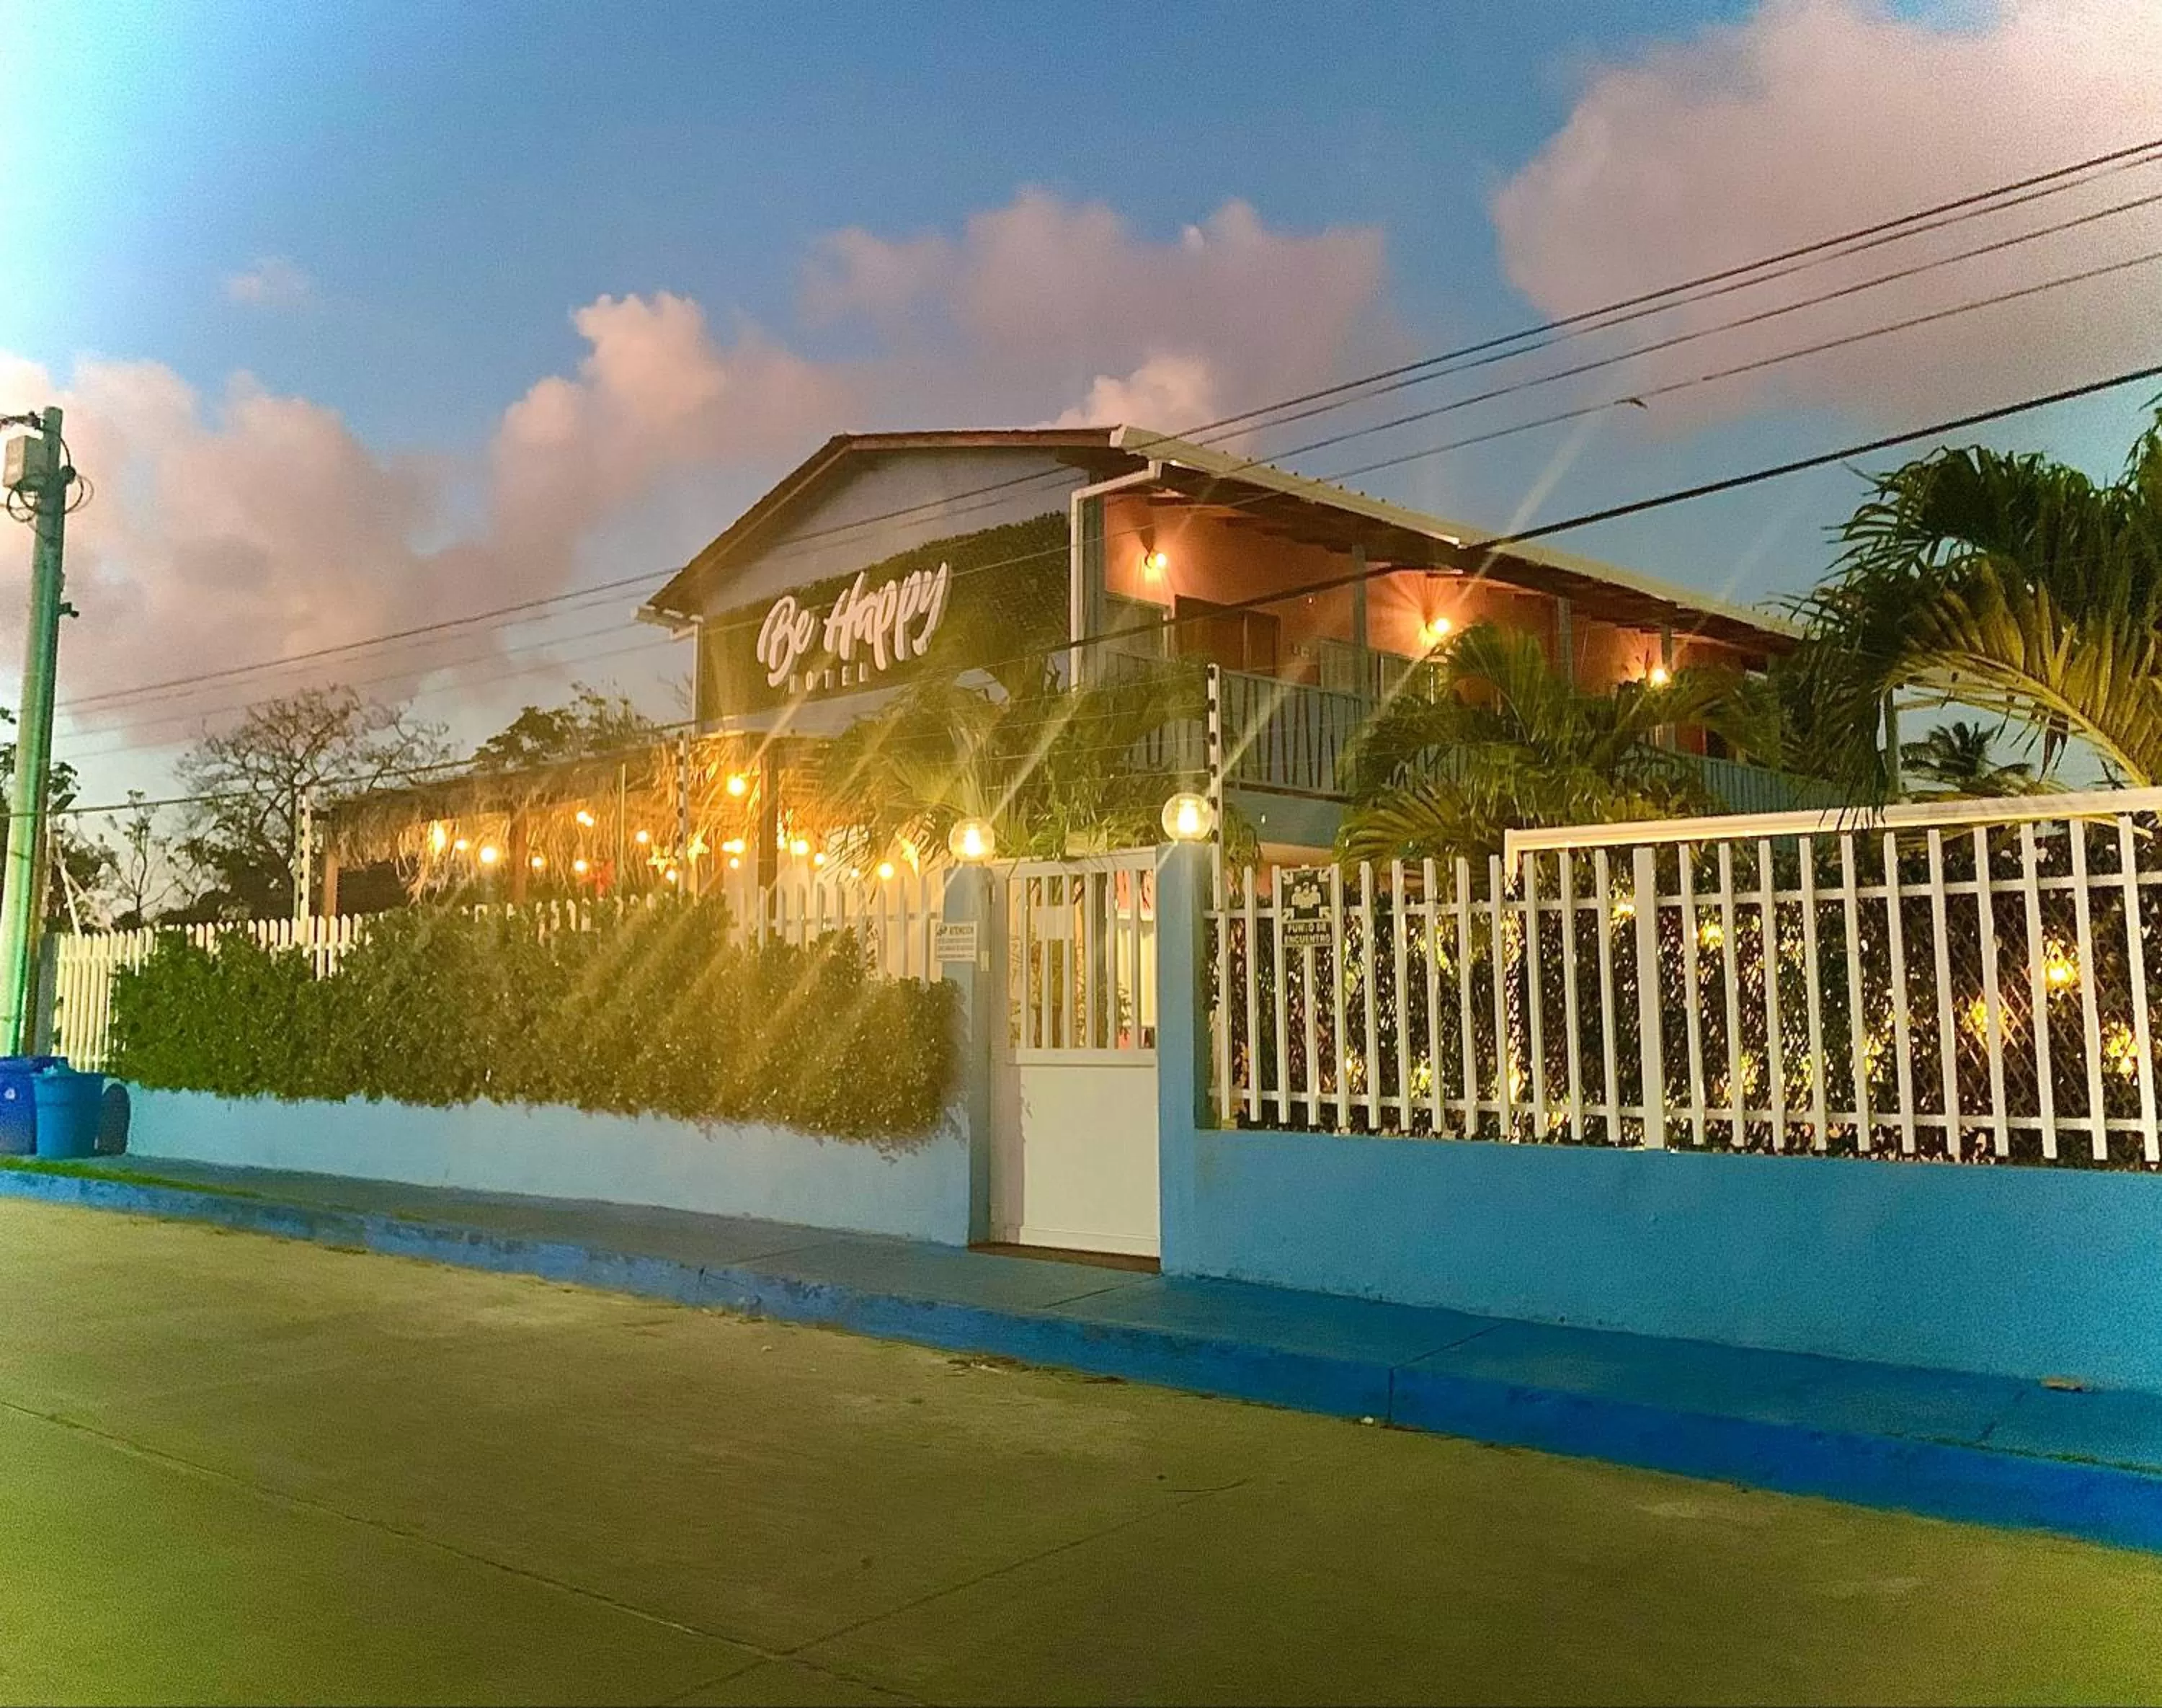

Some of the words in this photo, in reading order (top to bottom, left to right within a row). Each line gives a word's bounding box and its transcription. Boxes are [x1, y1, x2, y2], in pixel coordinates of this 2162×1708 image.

[757, 595, 815, 688] Be
[824, 561, 948, 672] Happy
[788, 662, 866, 694] HOTEL
